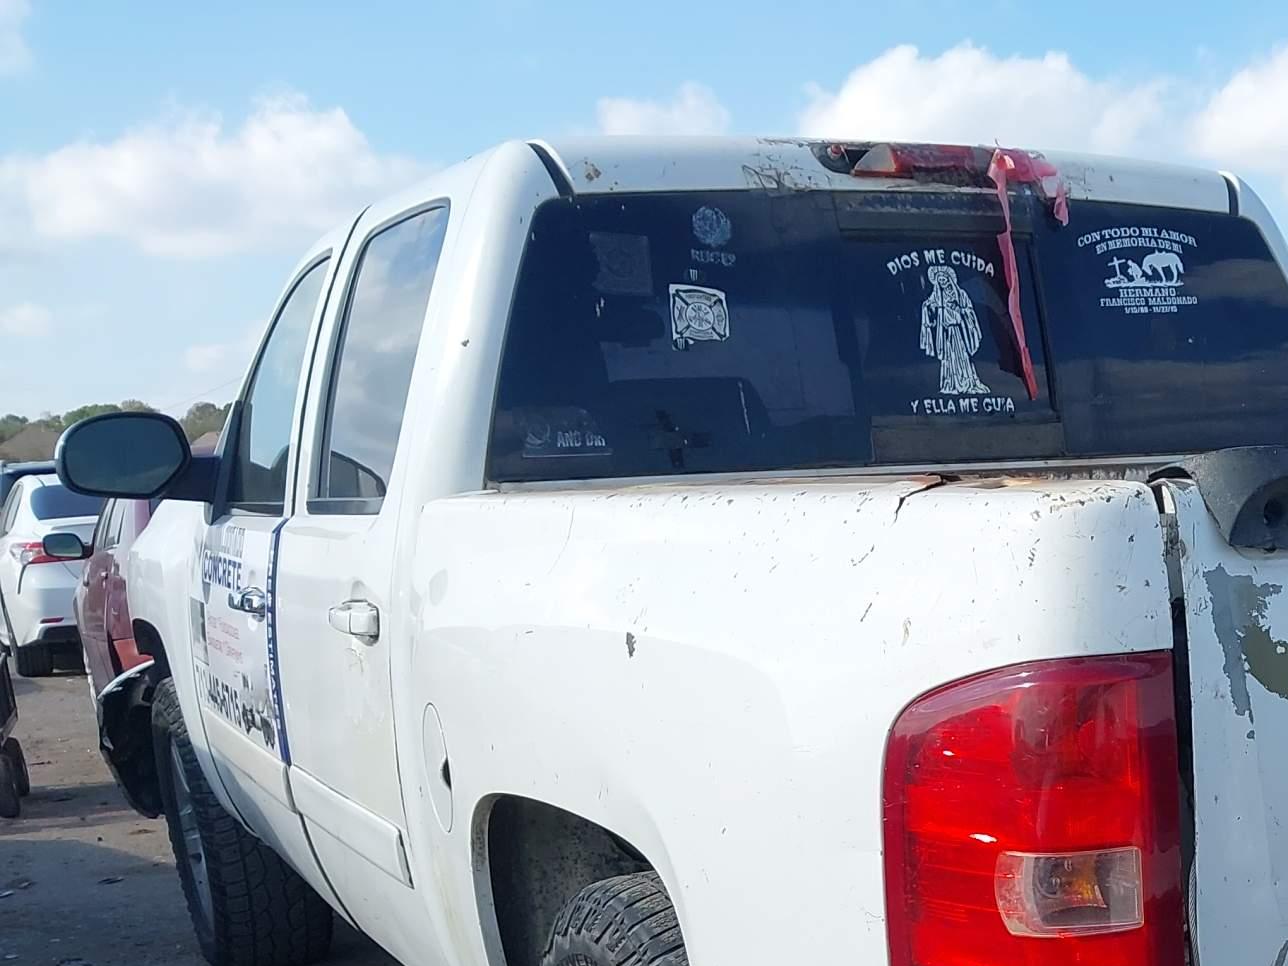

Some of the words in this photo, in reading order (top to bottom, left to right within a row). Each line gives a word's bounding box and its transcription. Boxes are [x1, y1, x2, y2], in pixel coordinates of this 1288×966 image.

[1077, 230, 1101, 247] CON
[1101, 226, 1140, 240] TODO
[1141, 227, 1158, 237] MI
[1160, 228, 1198, 247] AMOR
[1095, 243, 1108, 254] EN
[1108, 237, 1158, 249] MEMORIA
[1158, 239, 1171, 251] DE
[1172, 244, 1183, 254] MI
[886, 251, 920, 276] DIOS
[923, 249, 946, 264] ME
[950, 250, 996, 278] CUIDA
[1119, 287, 1177, 297] HERMANO
[1100, 297, 1147, 307] FRANCISCO
[1148, 296, 1198, 306] MALDONADO
[910, 399, 919, 414] Y
[923, 398, 956, 414] ELLA
[958, 397, 979, 413] ME
[203, 551, 242, 592] CONCRETE
